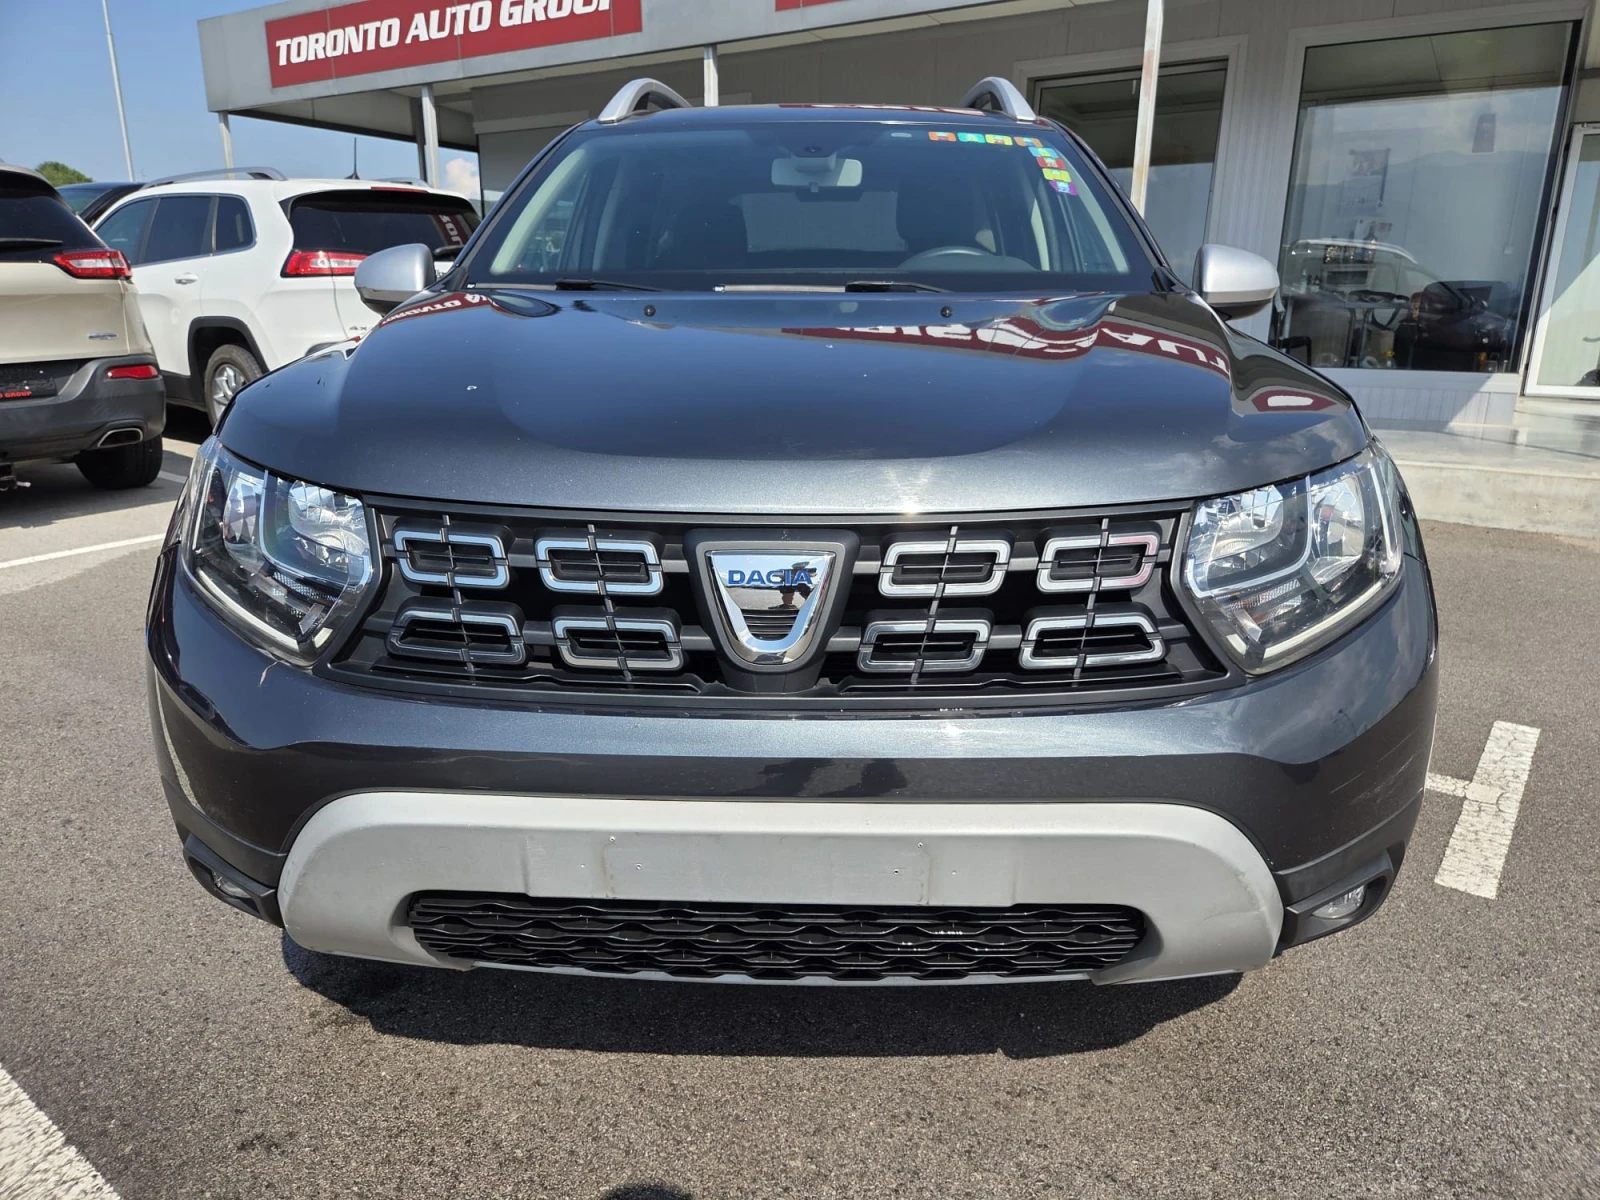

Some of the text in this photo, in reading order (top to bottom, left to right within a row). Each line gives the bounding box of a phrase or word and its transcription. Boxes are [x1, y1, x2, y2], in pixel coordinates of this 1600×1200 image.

[275, 17, 400, 66] TORONTO
[404, 5, 493, 44] AUTO
[728, 569, 813, 585] DACIA
